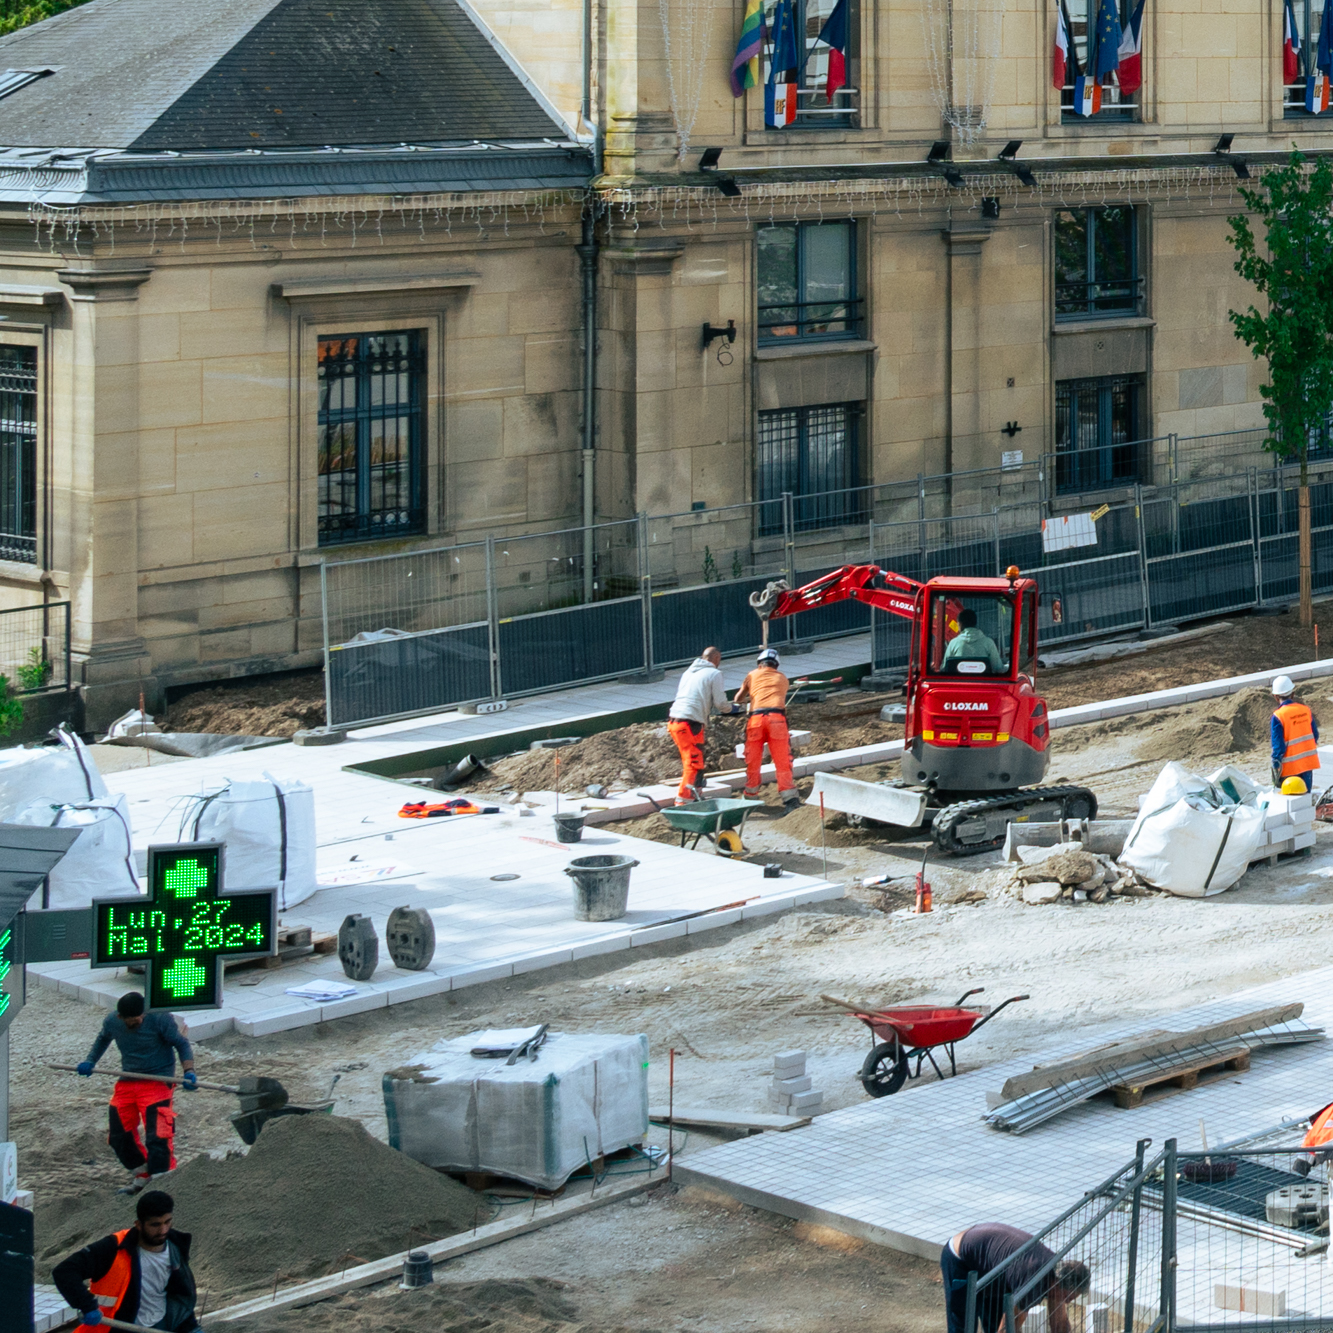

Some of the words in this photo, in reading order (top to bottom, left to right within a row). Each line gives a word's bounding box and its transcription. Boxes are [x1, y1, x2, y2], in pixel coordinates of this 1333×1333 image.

[952, 702, 988, 711] LOXAM
[108, 929, 165, 955] Mai
[184, 922, 264, 950] 2024
